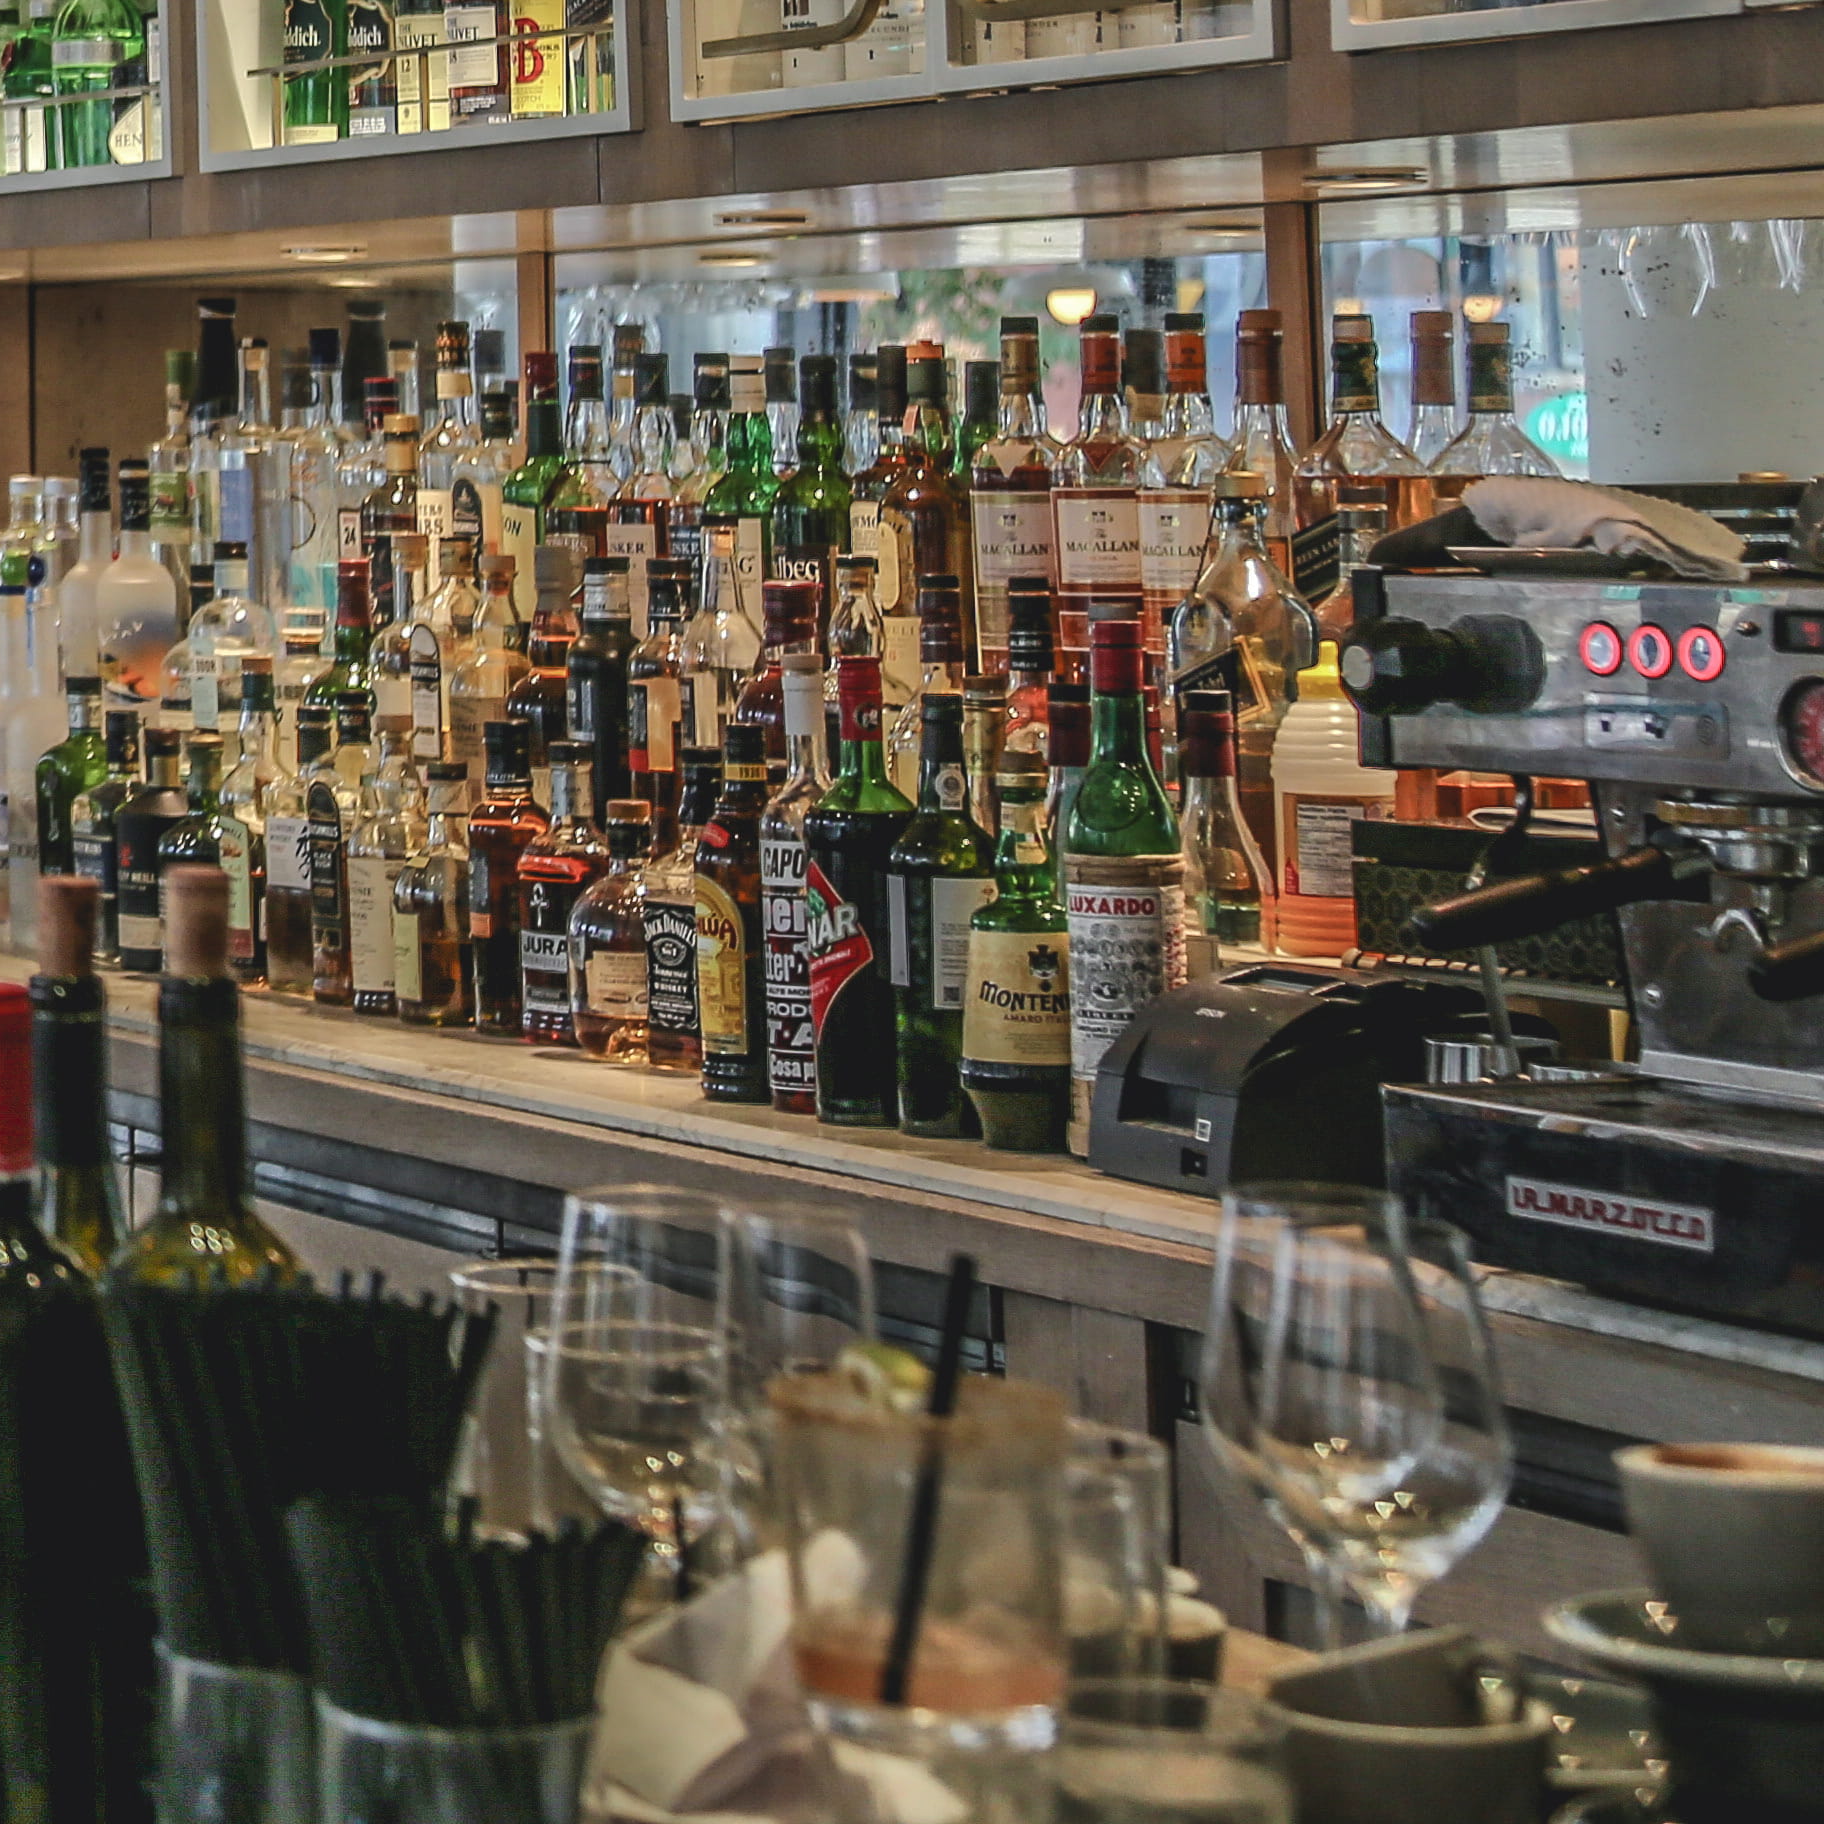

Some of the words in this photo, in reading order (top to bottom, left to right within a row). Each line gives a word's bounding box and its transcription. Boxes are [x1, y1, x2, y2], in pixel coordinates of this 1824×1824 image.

[285, 24, 322, 48] ddich.
[114, 133, 143, 148] HEN
[504, 517, 522, 537] ON
[609, 542, 645, 554] SKER
[980, 542, 1050, 557] MACALLAN
[1066, 539, 1140, 554] MACALLAN
[1069, 895, 1156, 917] LUXARDO
[523, 935, 569, 956] JURA
[979, 979, 1070, 1014] MONTEN
